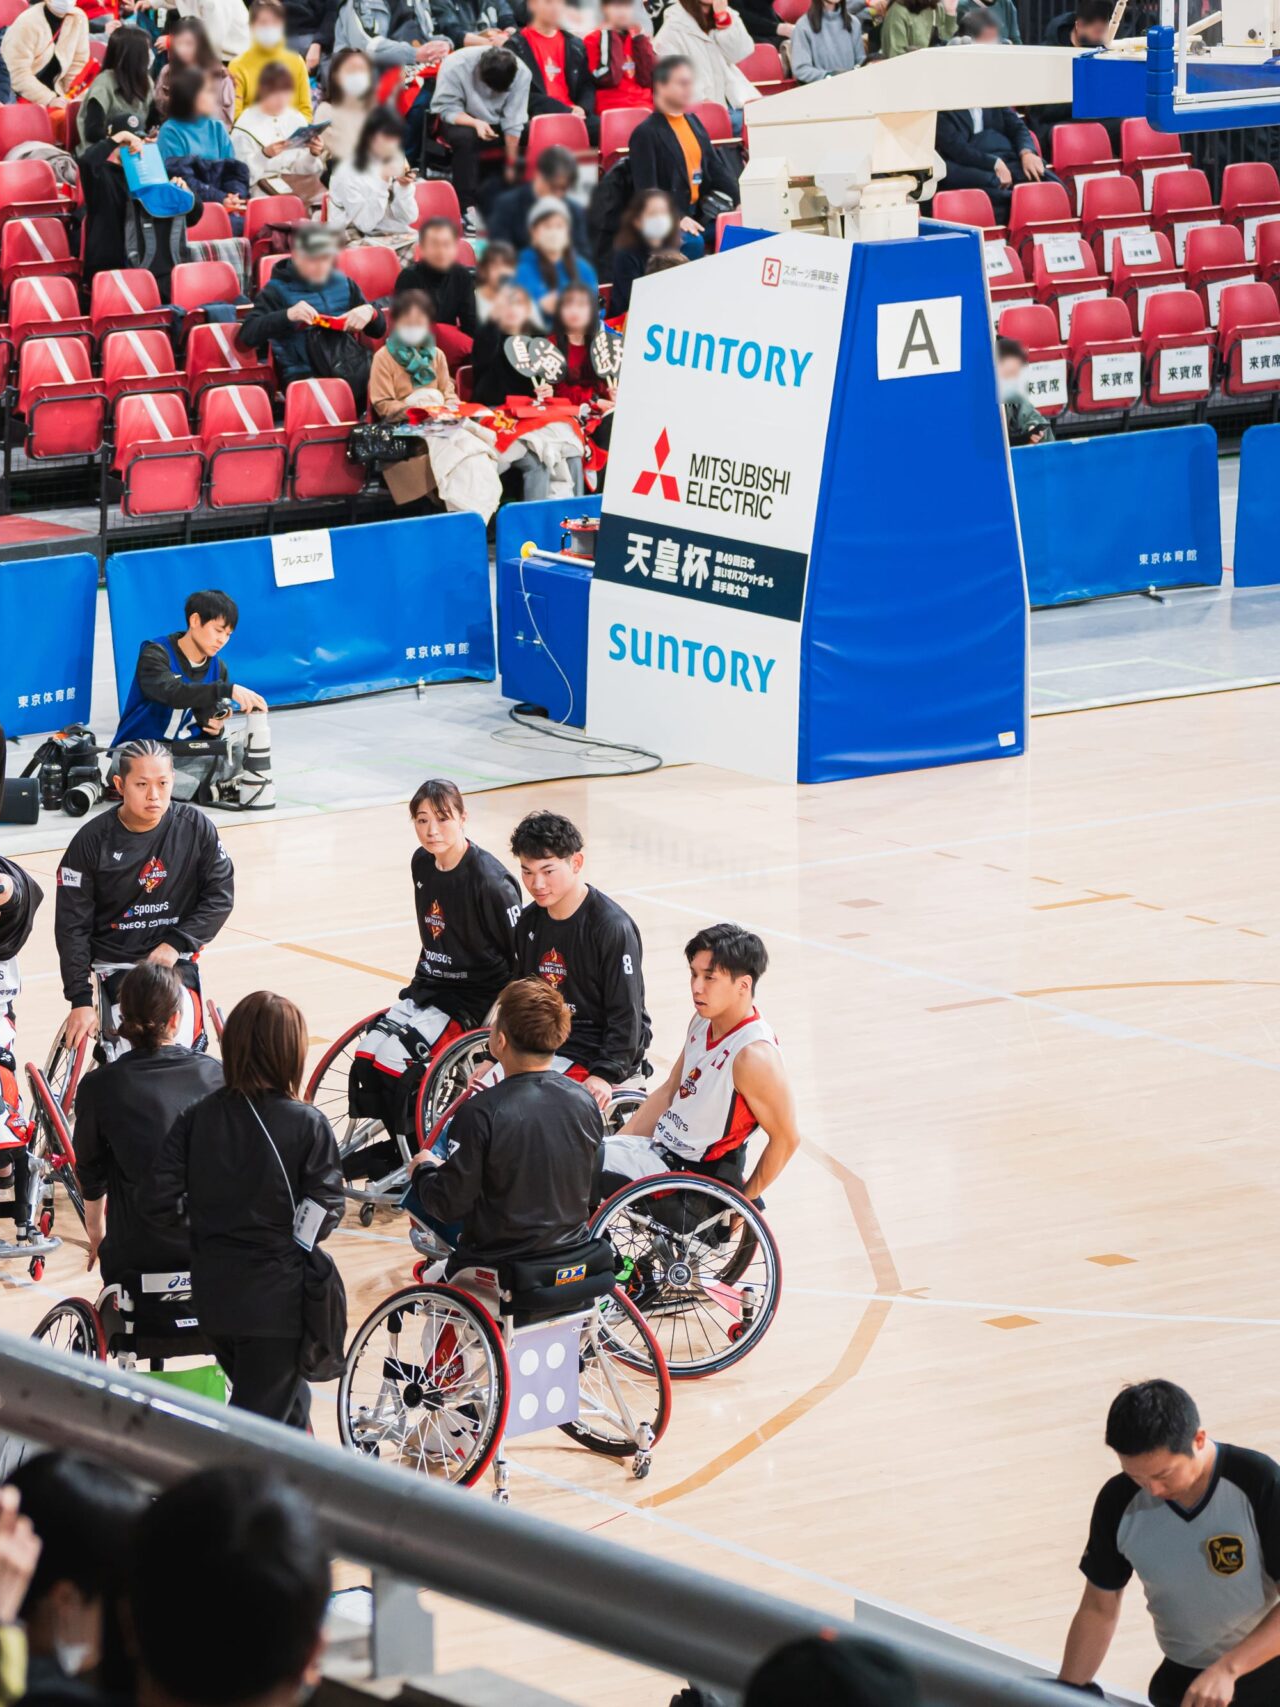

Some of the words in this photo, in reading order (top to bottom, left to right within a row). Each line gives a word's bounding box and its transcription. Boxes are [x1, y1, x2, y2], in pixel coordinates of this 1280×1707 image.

[897, 308, 940, 370] A
[689, 452, 791, 496] MITSUBISHI
[685, 480, 773, 521] ELECTRIC
[281, 551, 324, 567] プレスエリア
[624, 532, 712, 590] 天皇杯
[1139, 548, 1198, 566] 東京体育館
[405, 641, 471, 661] 東京体育館
[17, 686, 77, 710] 東京体育館
[622, 953, 634, 975] 8
